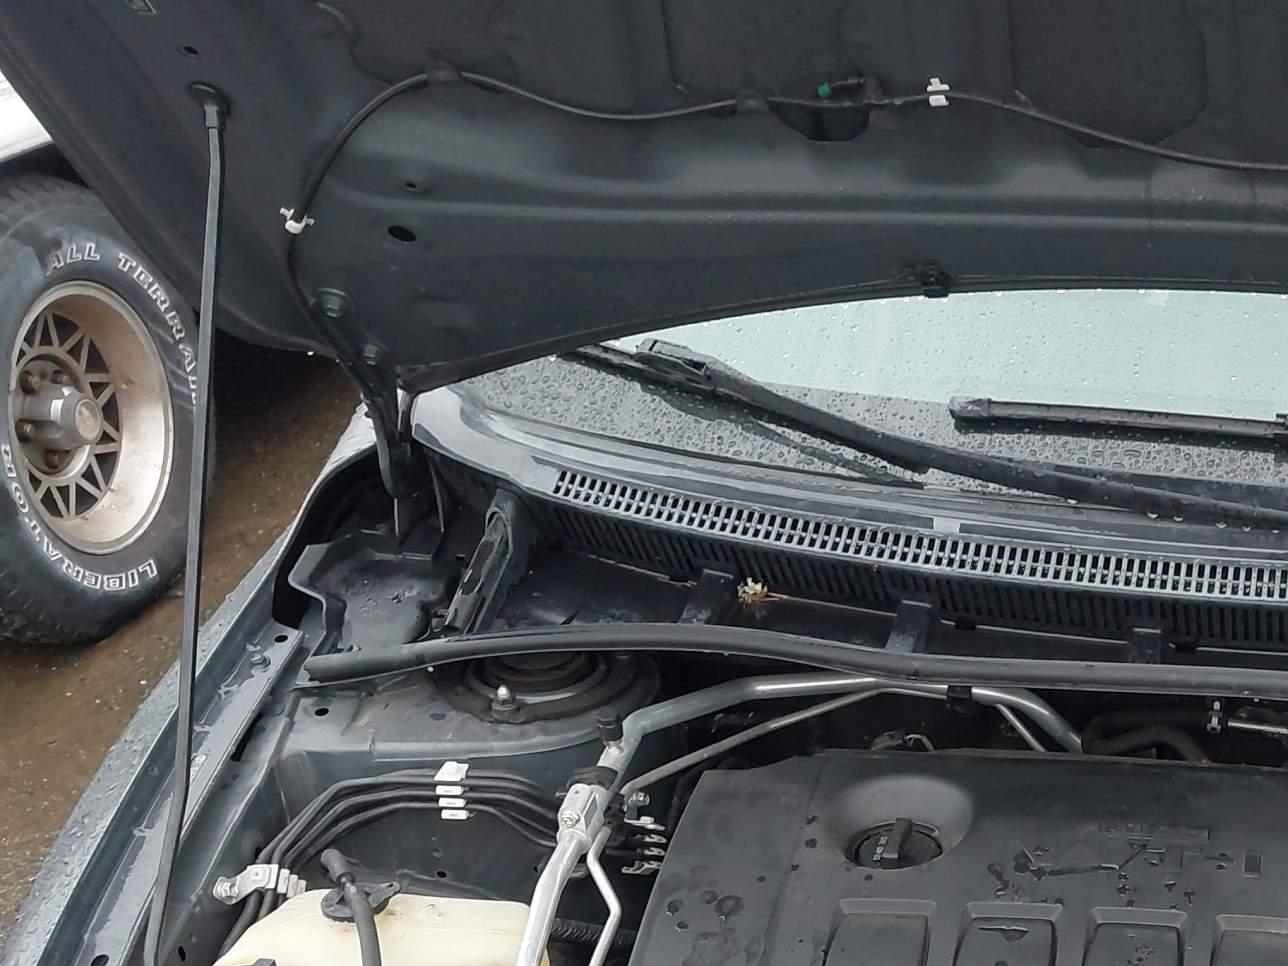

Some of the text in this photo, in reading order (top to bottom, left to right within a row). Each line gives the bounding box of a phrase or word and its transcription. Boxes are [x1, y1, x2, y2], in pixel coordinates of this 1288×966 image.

[46, 242, 198, 405] ALL TERRAI
[1, 443, 158, 591] LIBERATOR
